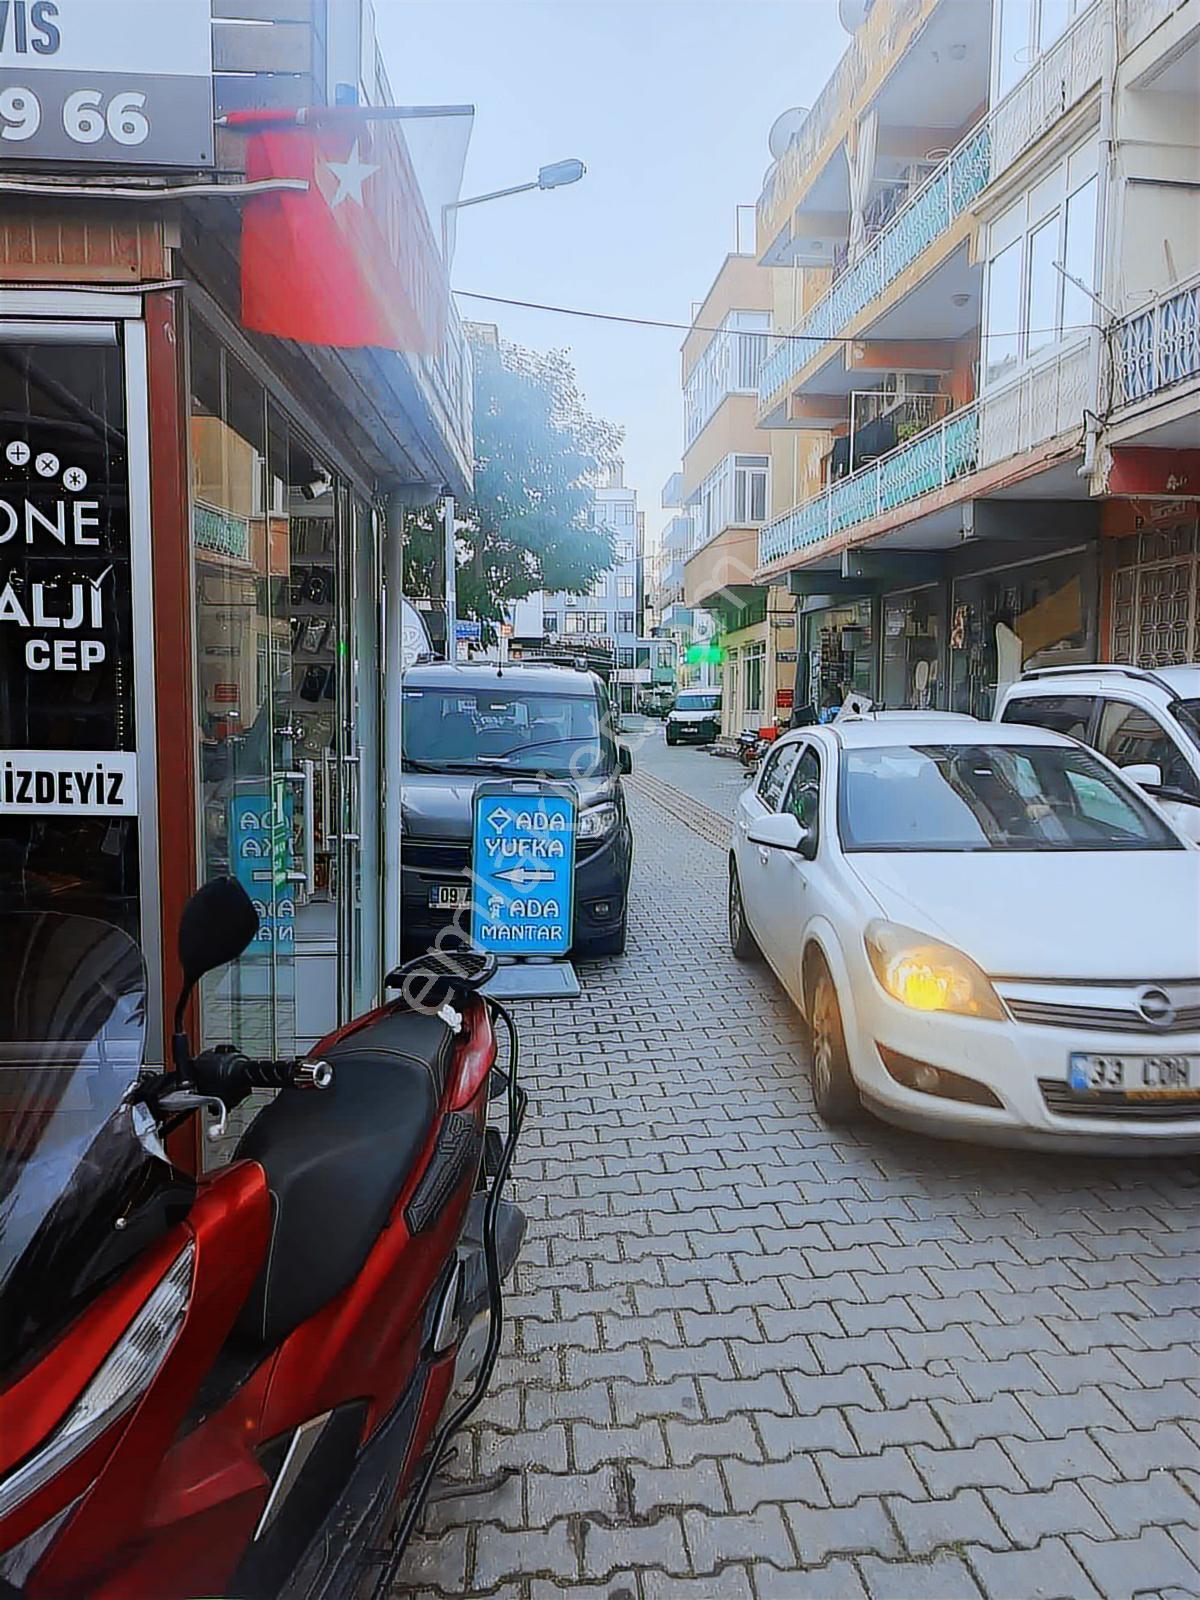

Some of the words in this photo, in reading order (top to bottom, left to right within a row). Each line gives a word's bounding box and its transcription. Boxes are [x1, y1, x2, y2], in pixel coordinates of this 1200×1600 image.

[0, 87, 41, 141] 9
[63, 90, 149, 145] 66
[25, 640, 106, 671] CEP
[4, 761, 124, 805] İZDEYİZ
[515, 812, 566, 831] ADA
[485, 838, 564, 858] YUFKA
[440, 887, 458, 904] 09
[509, 899, 560, 918] ADA
[481, 925, 564, 941] MANTAR
